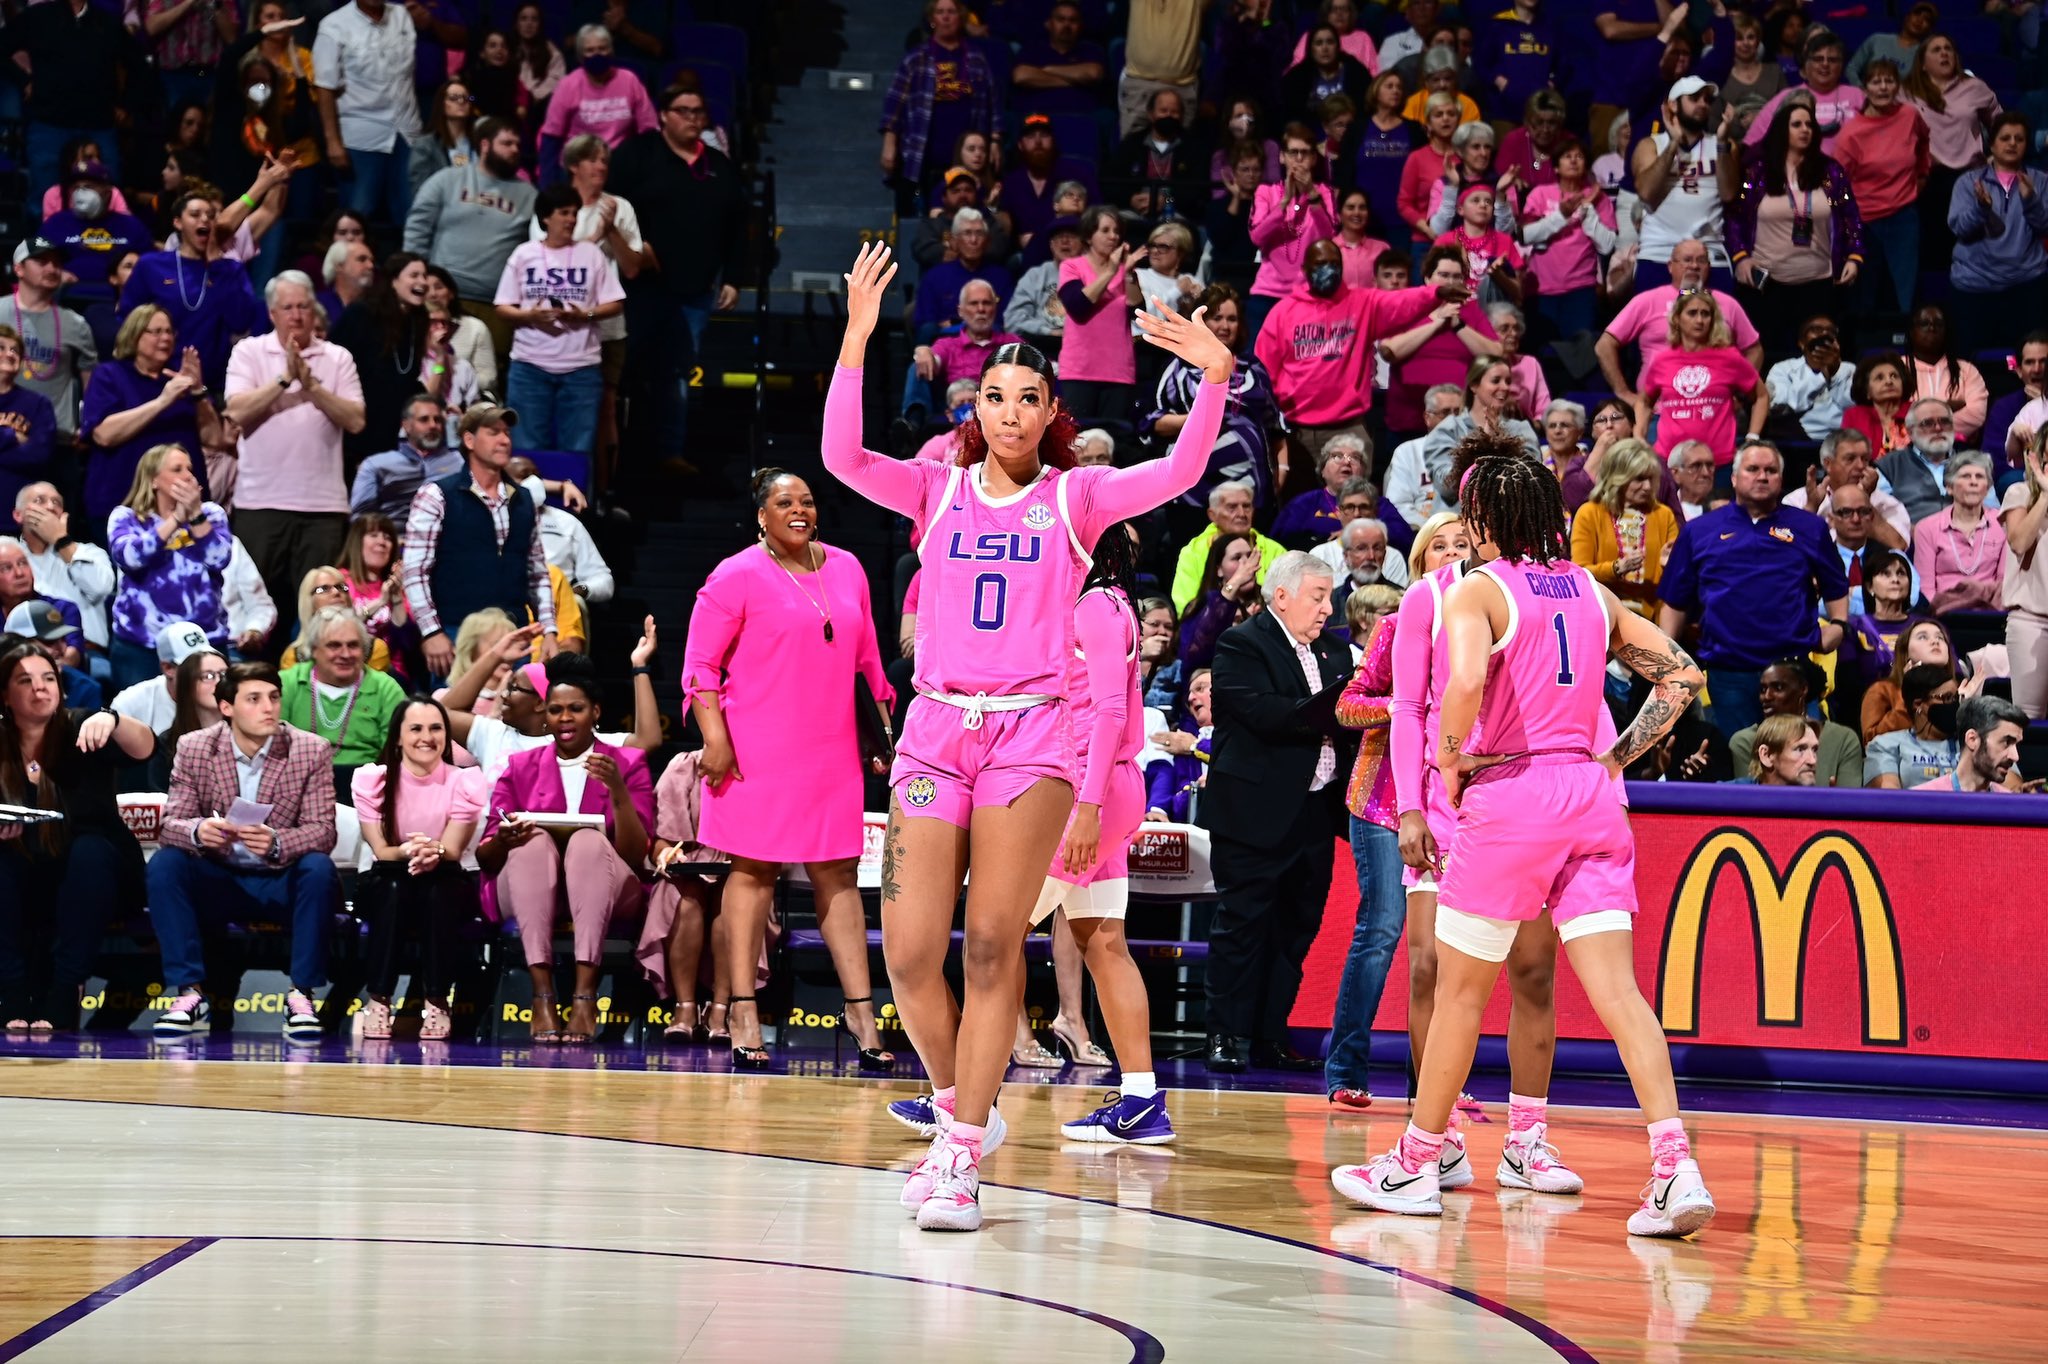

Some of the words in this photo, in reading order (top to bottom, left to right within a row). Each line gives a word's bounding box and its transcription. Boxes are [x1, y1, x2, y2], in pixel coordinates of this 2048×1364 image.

[460, 189, 515, 214] LSU
[525, 266, 589, 287] LSU
[1027, 505, 1051, 524] SEC
[948, 530, 1042, 564] LSU
[1524, 572, 1581, 600] CHERRY
[971, 571, 1008, 633] 0
[1552, 611, 1576, 687] 1
[1128, 842, 1183, 858] BUREAU
[1144, 832, 1182, 846] FARM
[1138, 860, 1182, 869] INSURANCE
